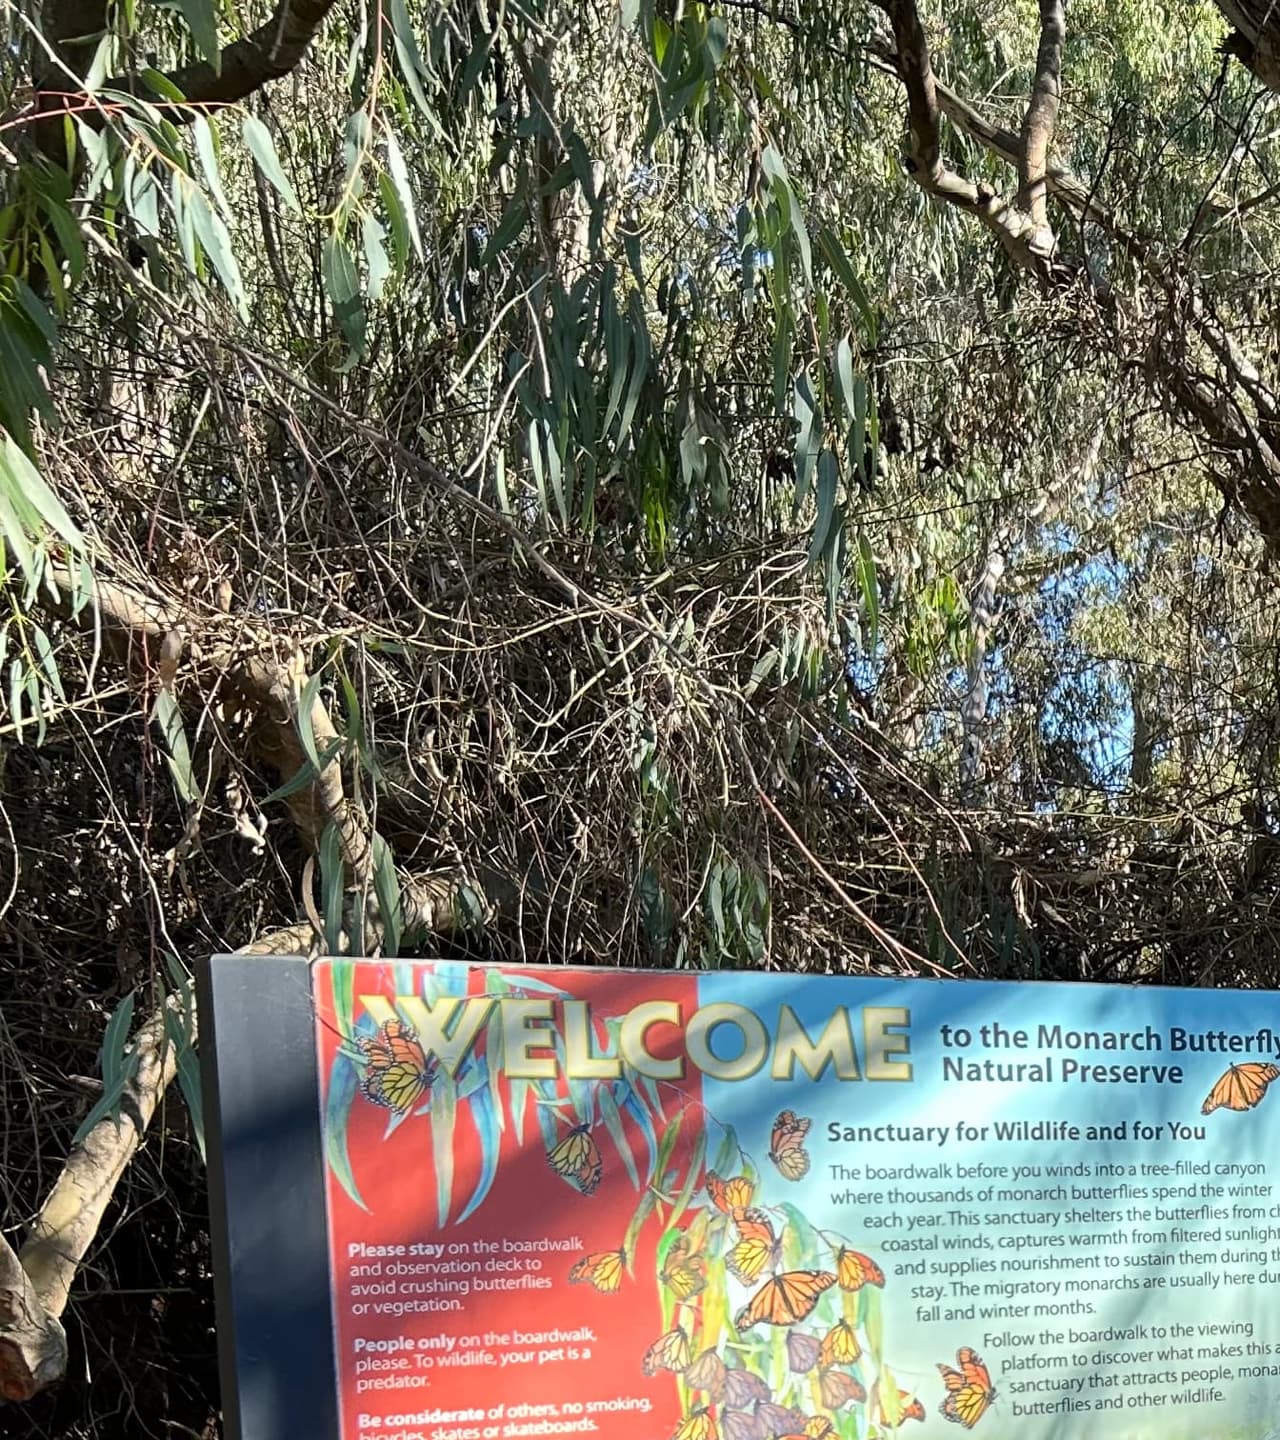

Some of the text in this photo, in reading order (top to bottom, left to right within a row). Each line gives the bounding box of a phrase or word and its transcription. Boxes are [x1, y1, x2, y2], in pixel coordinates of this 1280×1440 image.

[360, 996, 914, 1081] WELCOME
[941, 1024, 972, 1048] to
[979, 1023, 1029, 1049] the
[1037, 1025, 1162, 1051] Monarch
[943, 1057, 1184, 1084] Natural Preserve
[827, 1119, 1206, 1147] Sanctuary for Wildlife and for You
[828, 1160, 1265, 1182] The boardwalk before you winds into a tree-filled canyon
[830, 1181, 1272, 1204] where thousands of monarch butterflies spend the winter
[862, 1211, 902, 1228] each
[906, 1215, 945, 1231] year.
[946, 1210, 980, 1225] This
[984, 1211, 1061, 1227] sanctuary
[1064, 1207, 1123, 1223] shelters
[1126, 1206, 1151, 1221] the
[1155, 1204, 1229, 1220] butterflies
[1232, 1203, 1265, 1218] from
[347, 1236, 584, 1258] Please stay on the boardwalk
[349, 1256, 542, 1276] and observation deck to
[350, 1273, 552, 1296] avoid crushing butterflies
[351, 1297, 464, 1316] or vegetation.
[354, 1327, 597, 1354] People only on the boardwalk,
